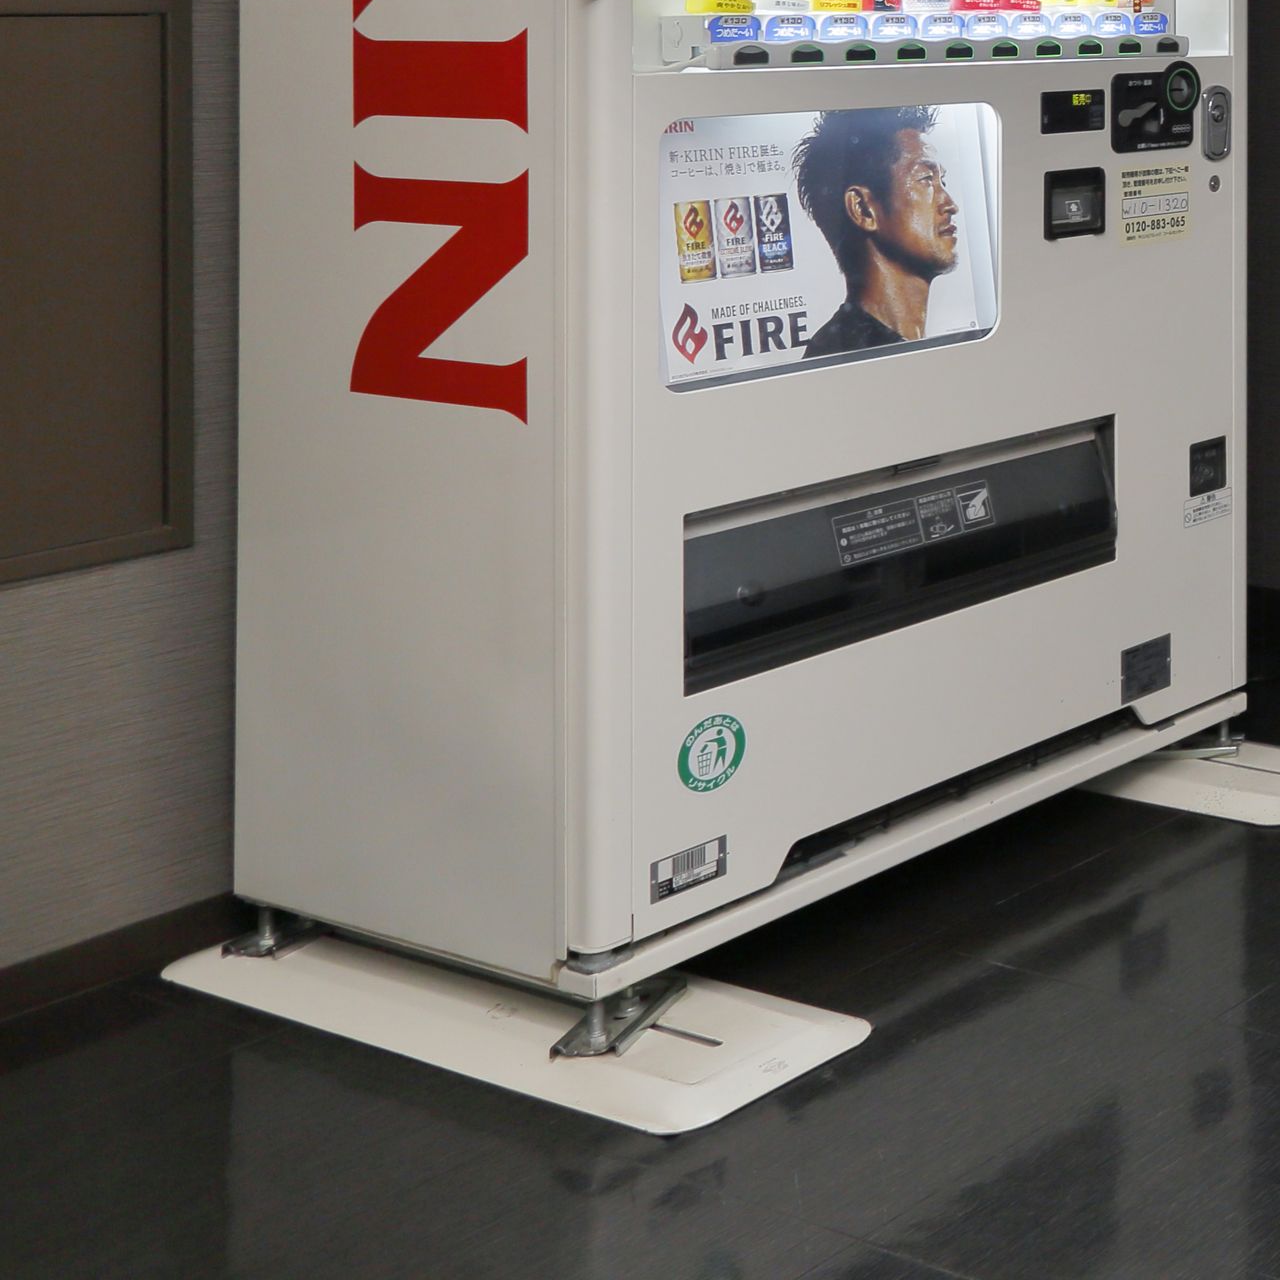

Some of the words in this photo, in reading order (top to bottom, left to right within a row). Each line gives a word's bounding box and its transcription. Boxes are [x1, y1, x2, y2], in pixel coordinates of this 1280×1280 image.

[664, 121, 694, 134] RIN
[1125, 216, 1186, 233] 0120-883-065
[726, 237, 745, 246] FIRE
[765, 233, 784, 242] FIRE
[686, 241, 706, 250] FIRE
[763, 242, 786, 251] BLACK
[711, 305, 736, 320] MADE
[739, 303, 750, 315] OF
[711, 311, 812, 361] FIRE
[688, 766, 735, 791] リサイクル
